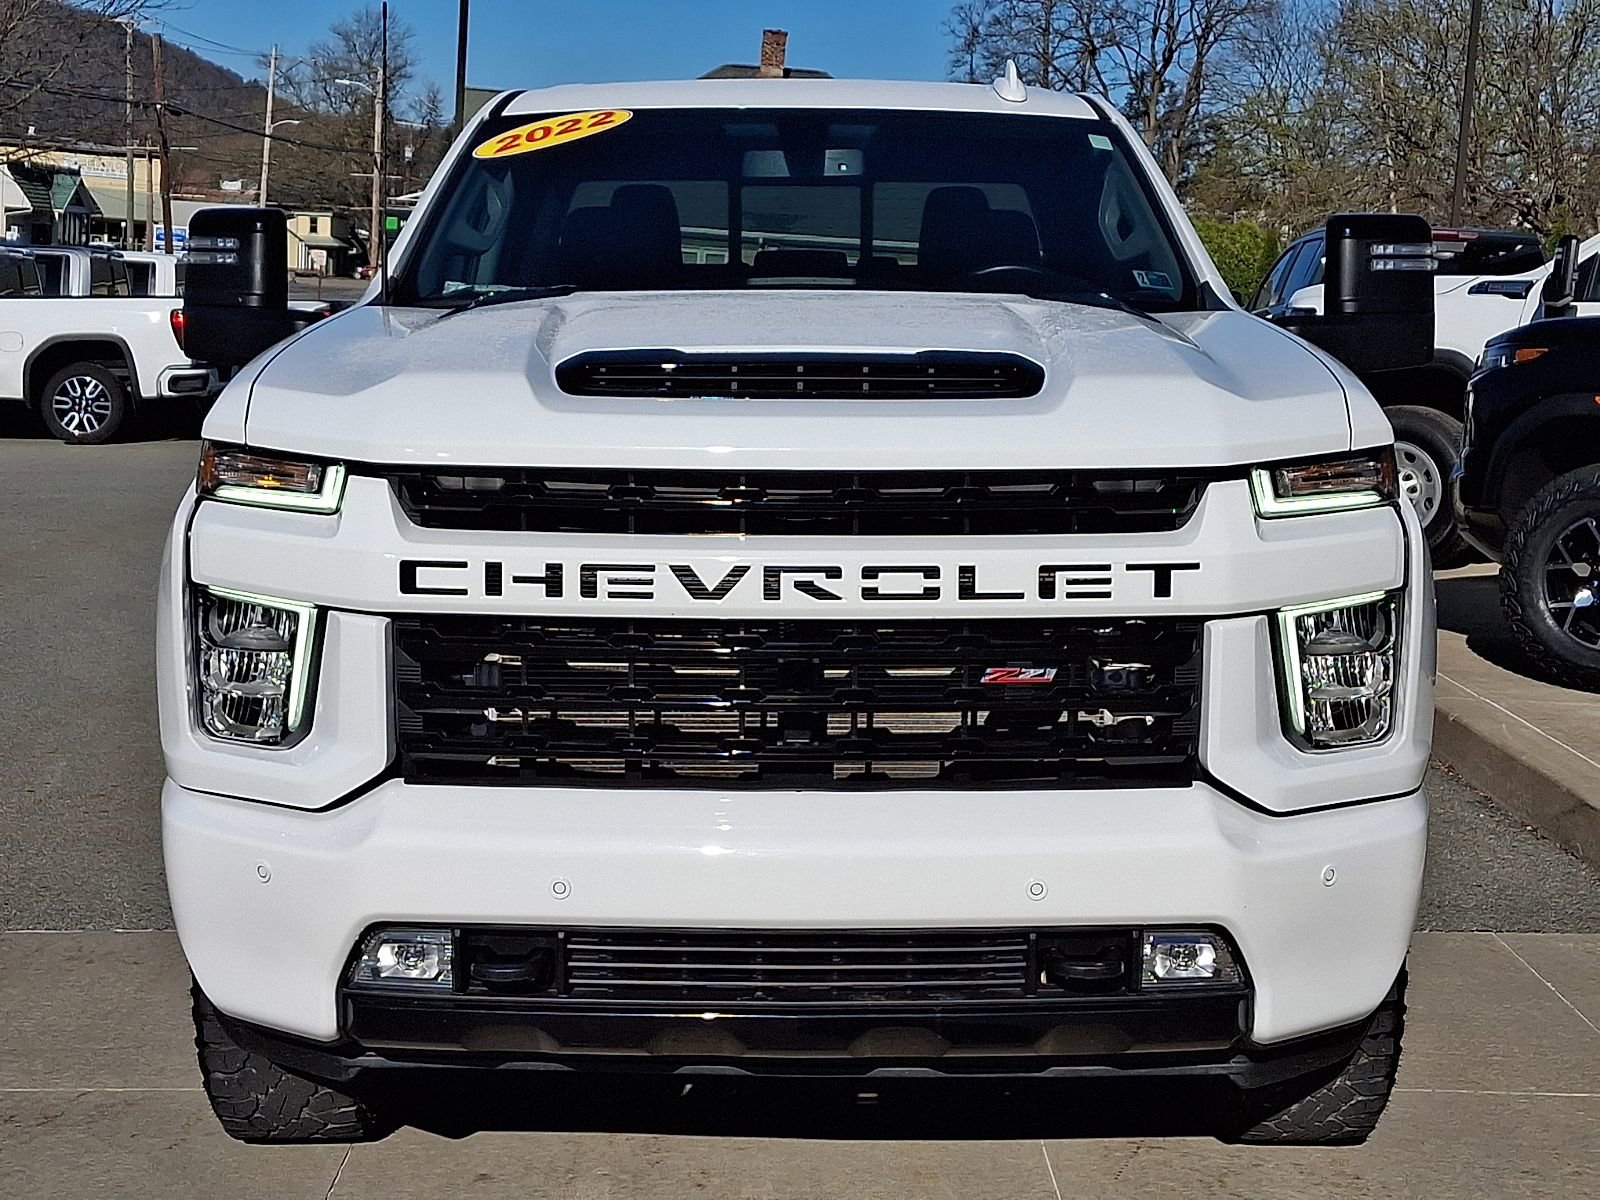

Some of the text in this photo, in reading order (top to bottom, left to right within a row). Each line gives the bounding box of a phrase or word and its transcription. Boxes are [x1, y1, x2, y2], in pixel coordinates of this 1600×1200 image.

[493, 111, 617, 155] 2022
[399, 560, 1201, 601] CHEVROLET
[980, 667, 1058, 685] Z71
